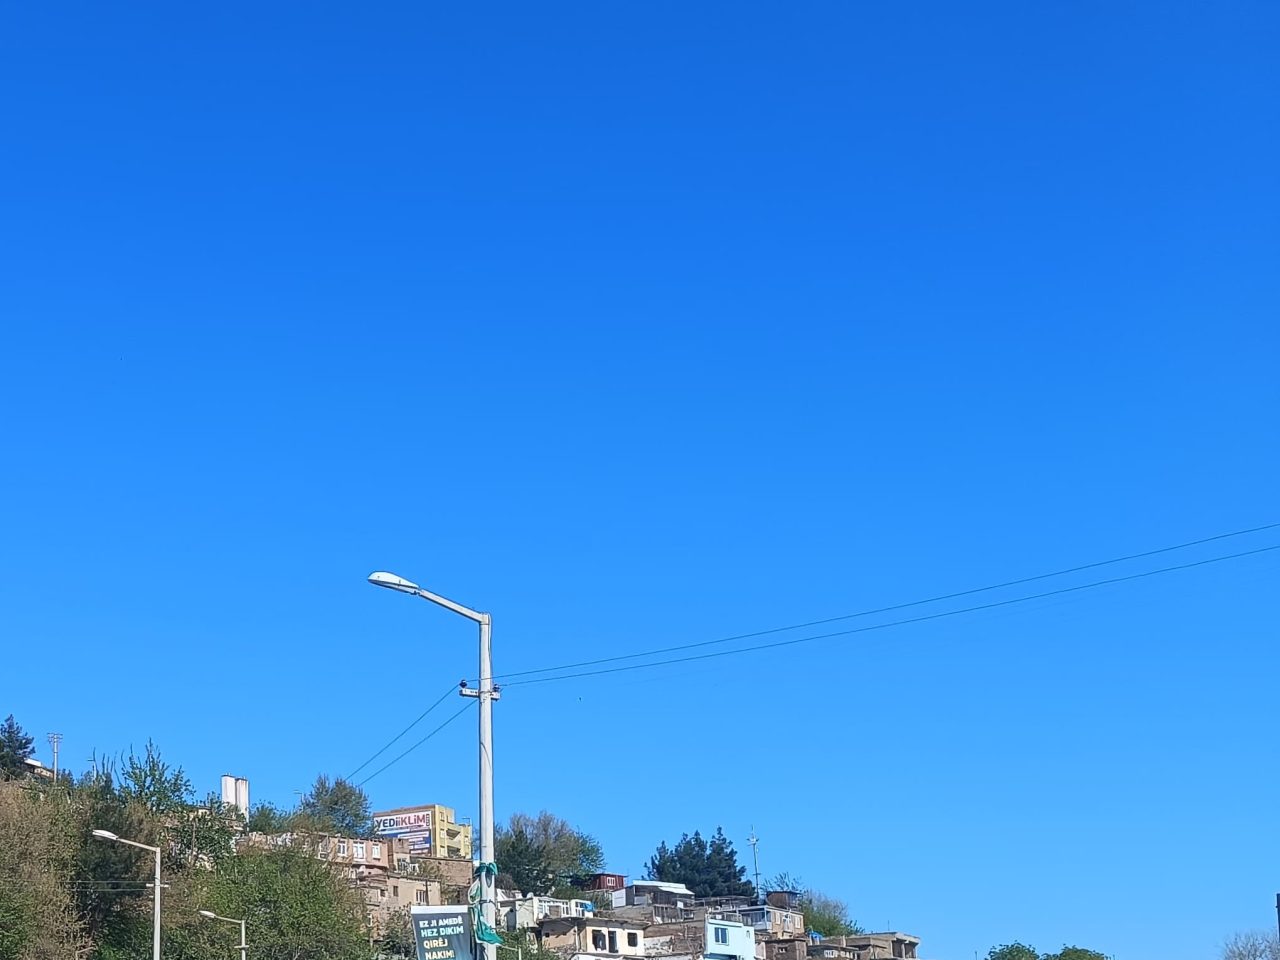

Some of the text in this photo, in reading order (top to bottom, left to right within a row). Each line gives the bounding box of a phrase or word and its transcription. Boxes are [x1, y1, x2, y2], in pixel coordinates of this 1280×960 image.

[419, 915, 463, 928] EZ JI AMEDÊ
[421, 928, 438, 937] HEZ
[423, 936, 448, 949] QIRÊJ
